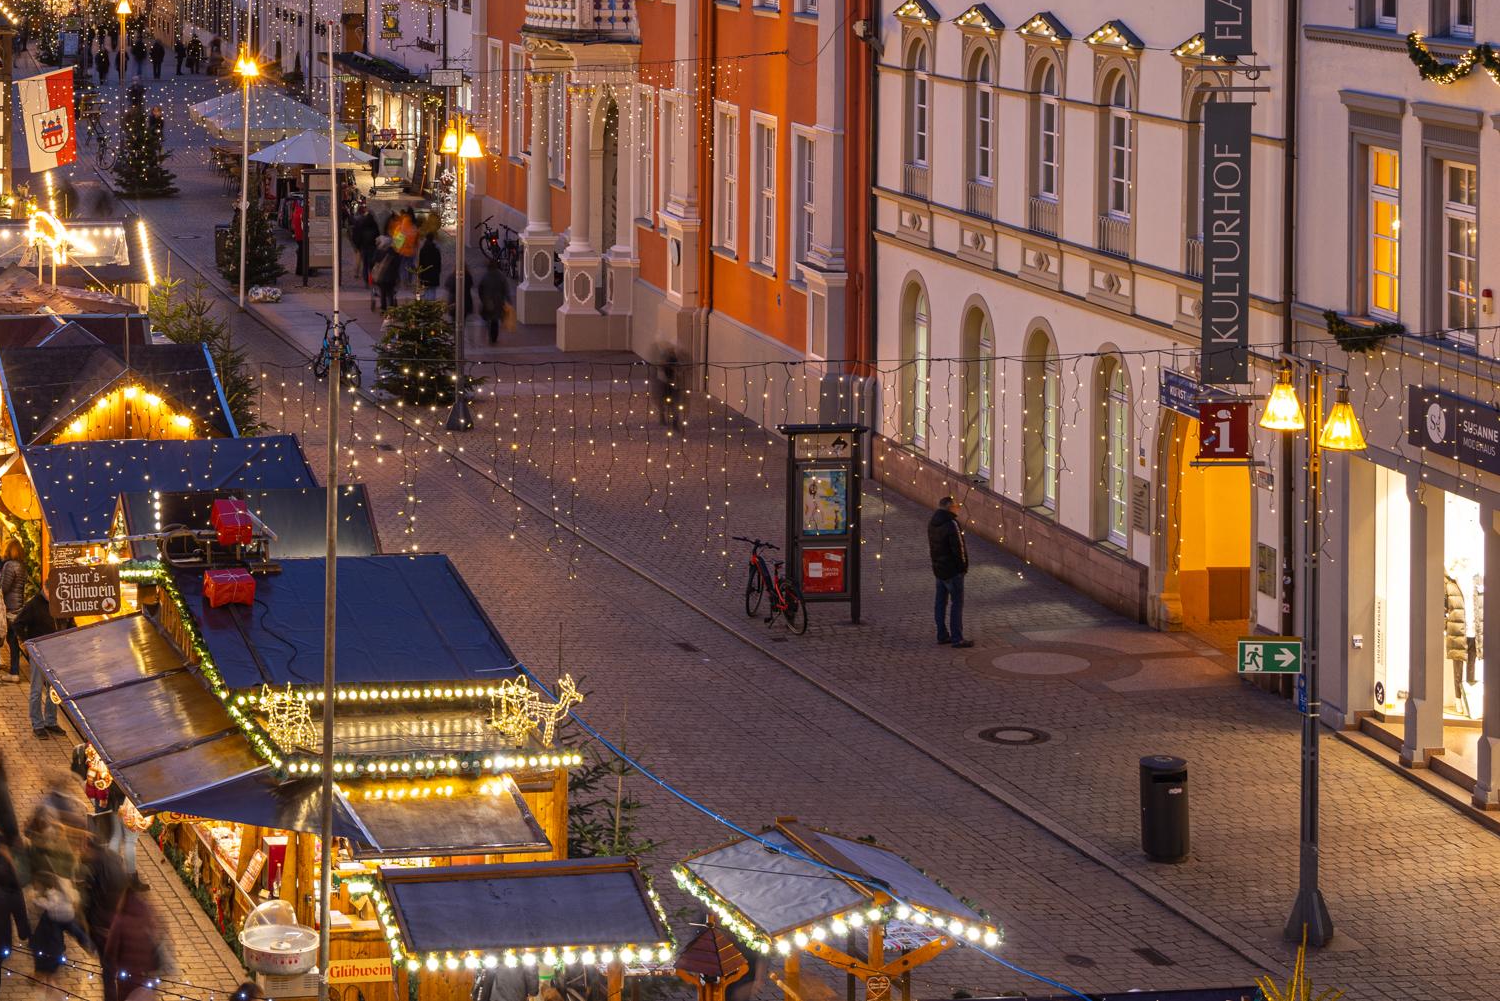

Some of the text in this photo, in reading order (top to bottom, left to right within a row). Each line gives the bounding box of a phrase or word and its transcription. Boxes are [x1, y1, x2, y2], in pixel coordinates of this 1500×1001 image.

[1211, 143, 1241, 343] KULTURHOF
[1463, 420, 1499, 443] SUSANNE
[55, 582, 116, 600] Glühwein
[60, 599, 100, 613] Klause
[329, 963, 391, 979] Glühwein
